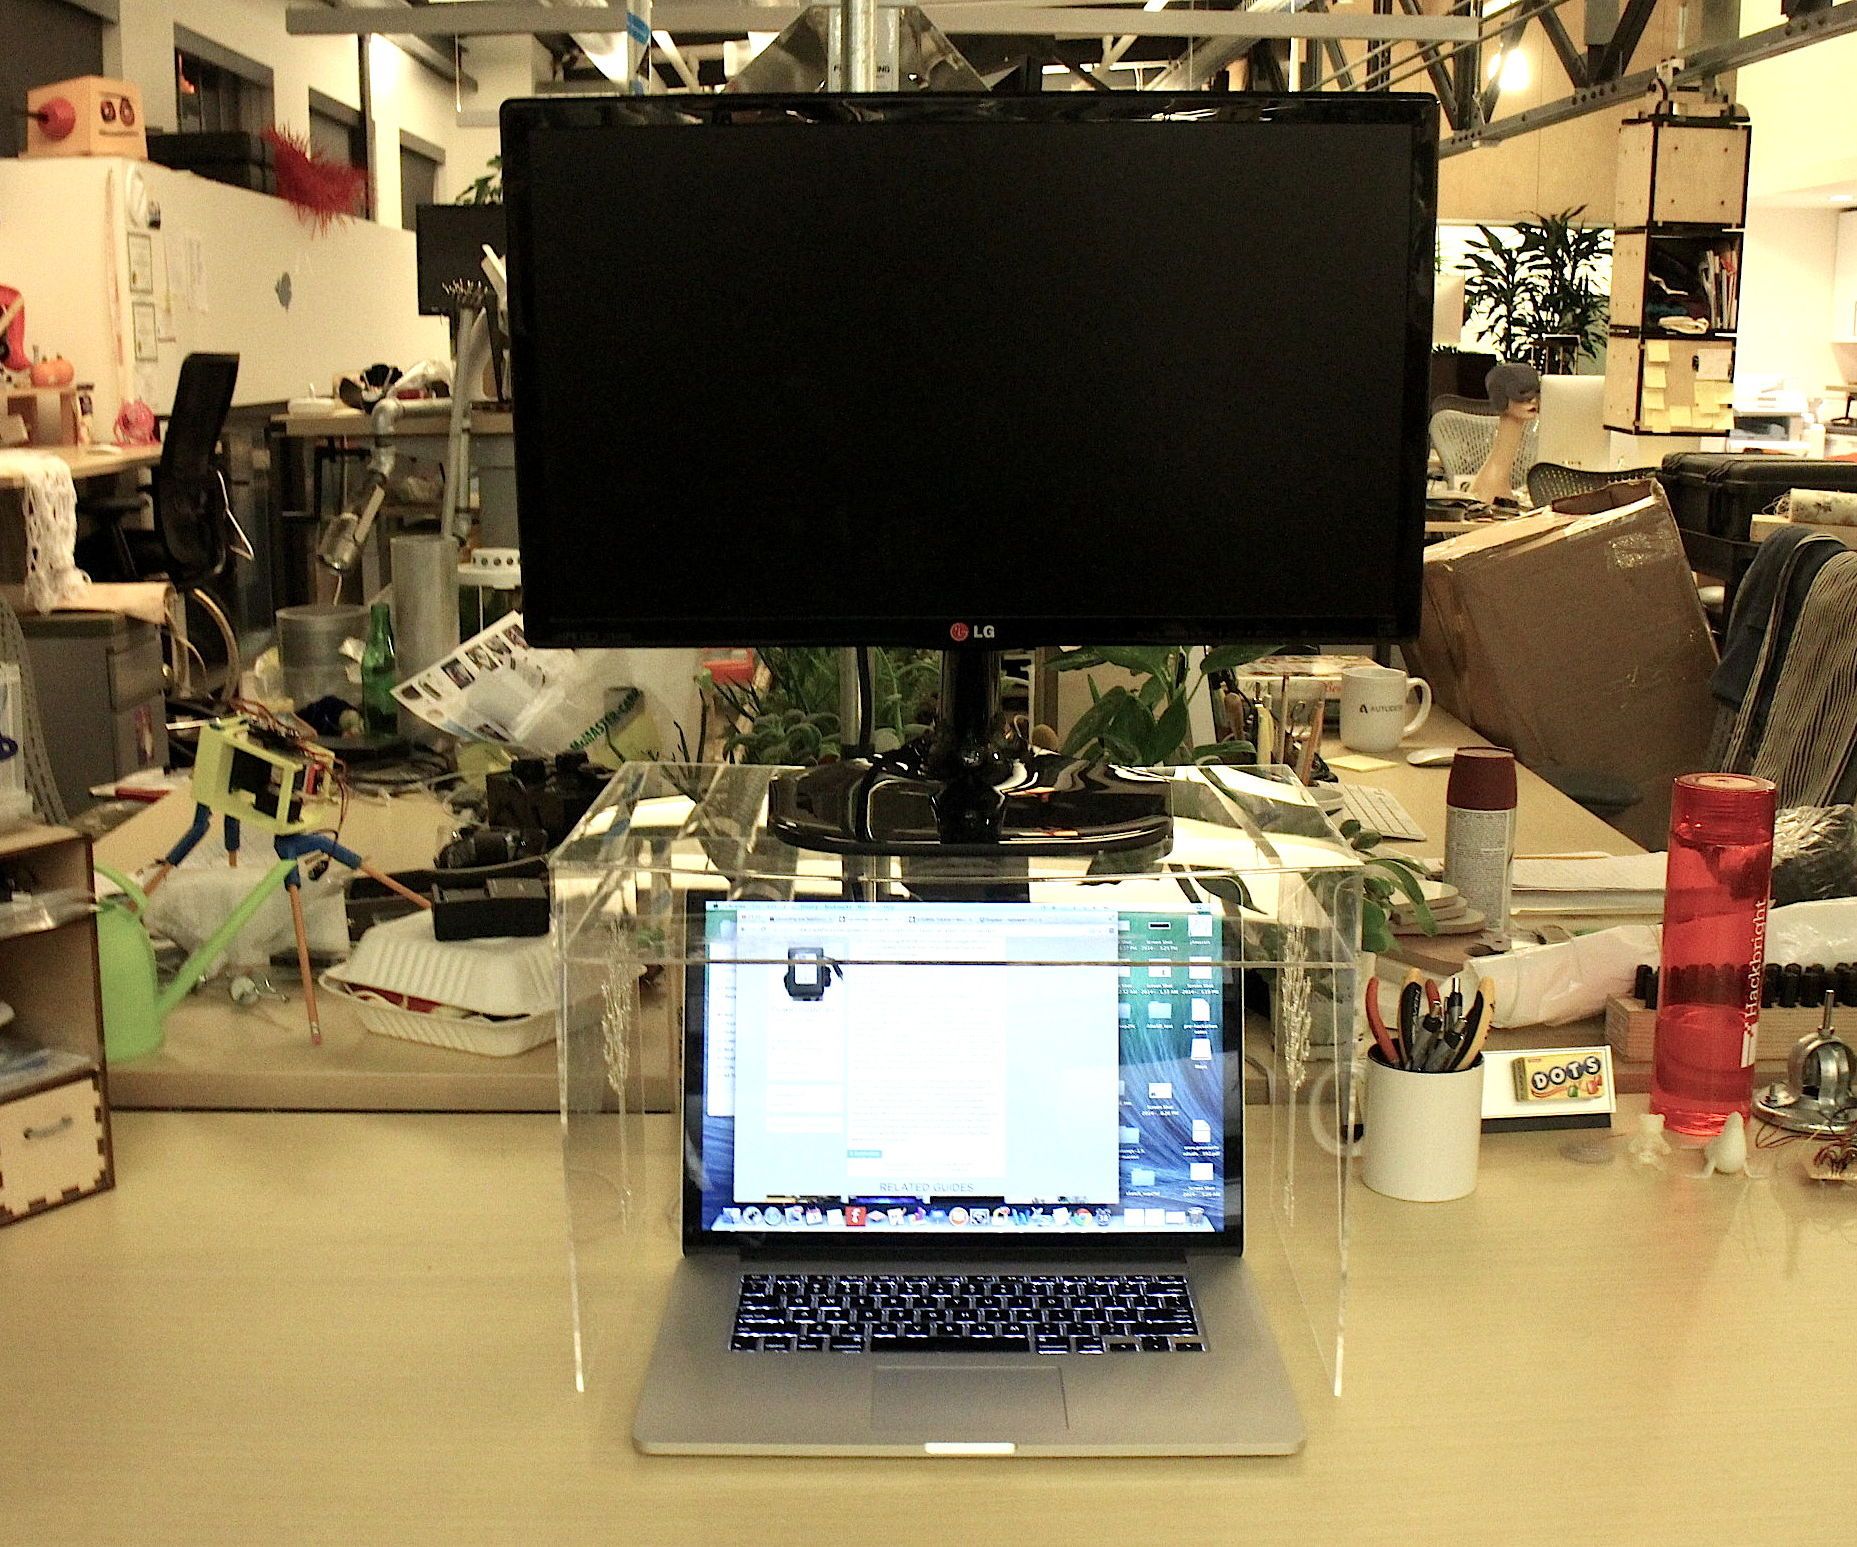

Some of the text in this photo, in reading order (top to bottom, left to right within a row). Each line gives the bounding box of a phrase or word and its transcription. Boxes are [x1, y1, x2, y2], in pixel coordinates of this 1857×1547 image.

[973, 624, 995, 639] LG
[1370, 703, 1403, 714] AUTODE
[1744, 898, 1766, 1017] Hackbright
[1533, 1056, 1600, 1090] DOTS
[879, 1182, 974, 1192] RELATED GUIDES
